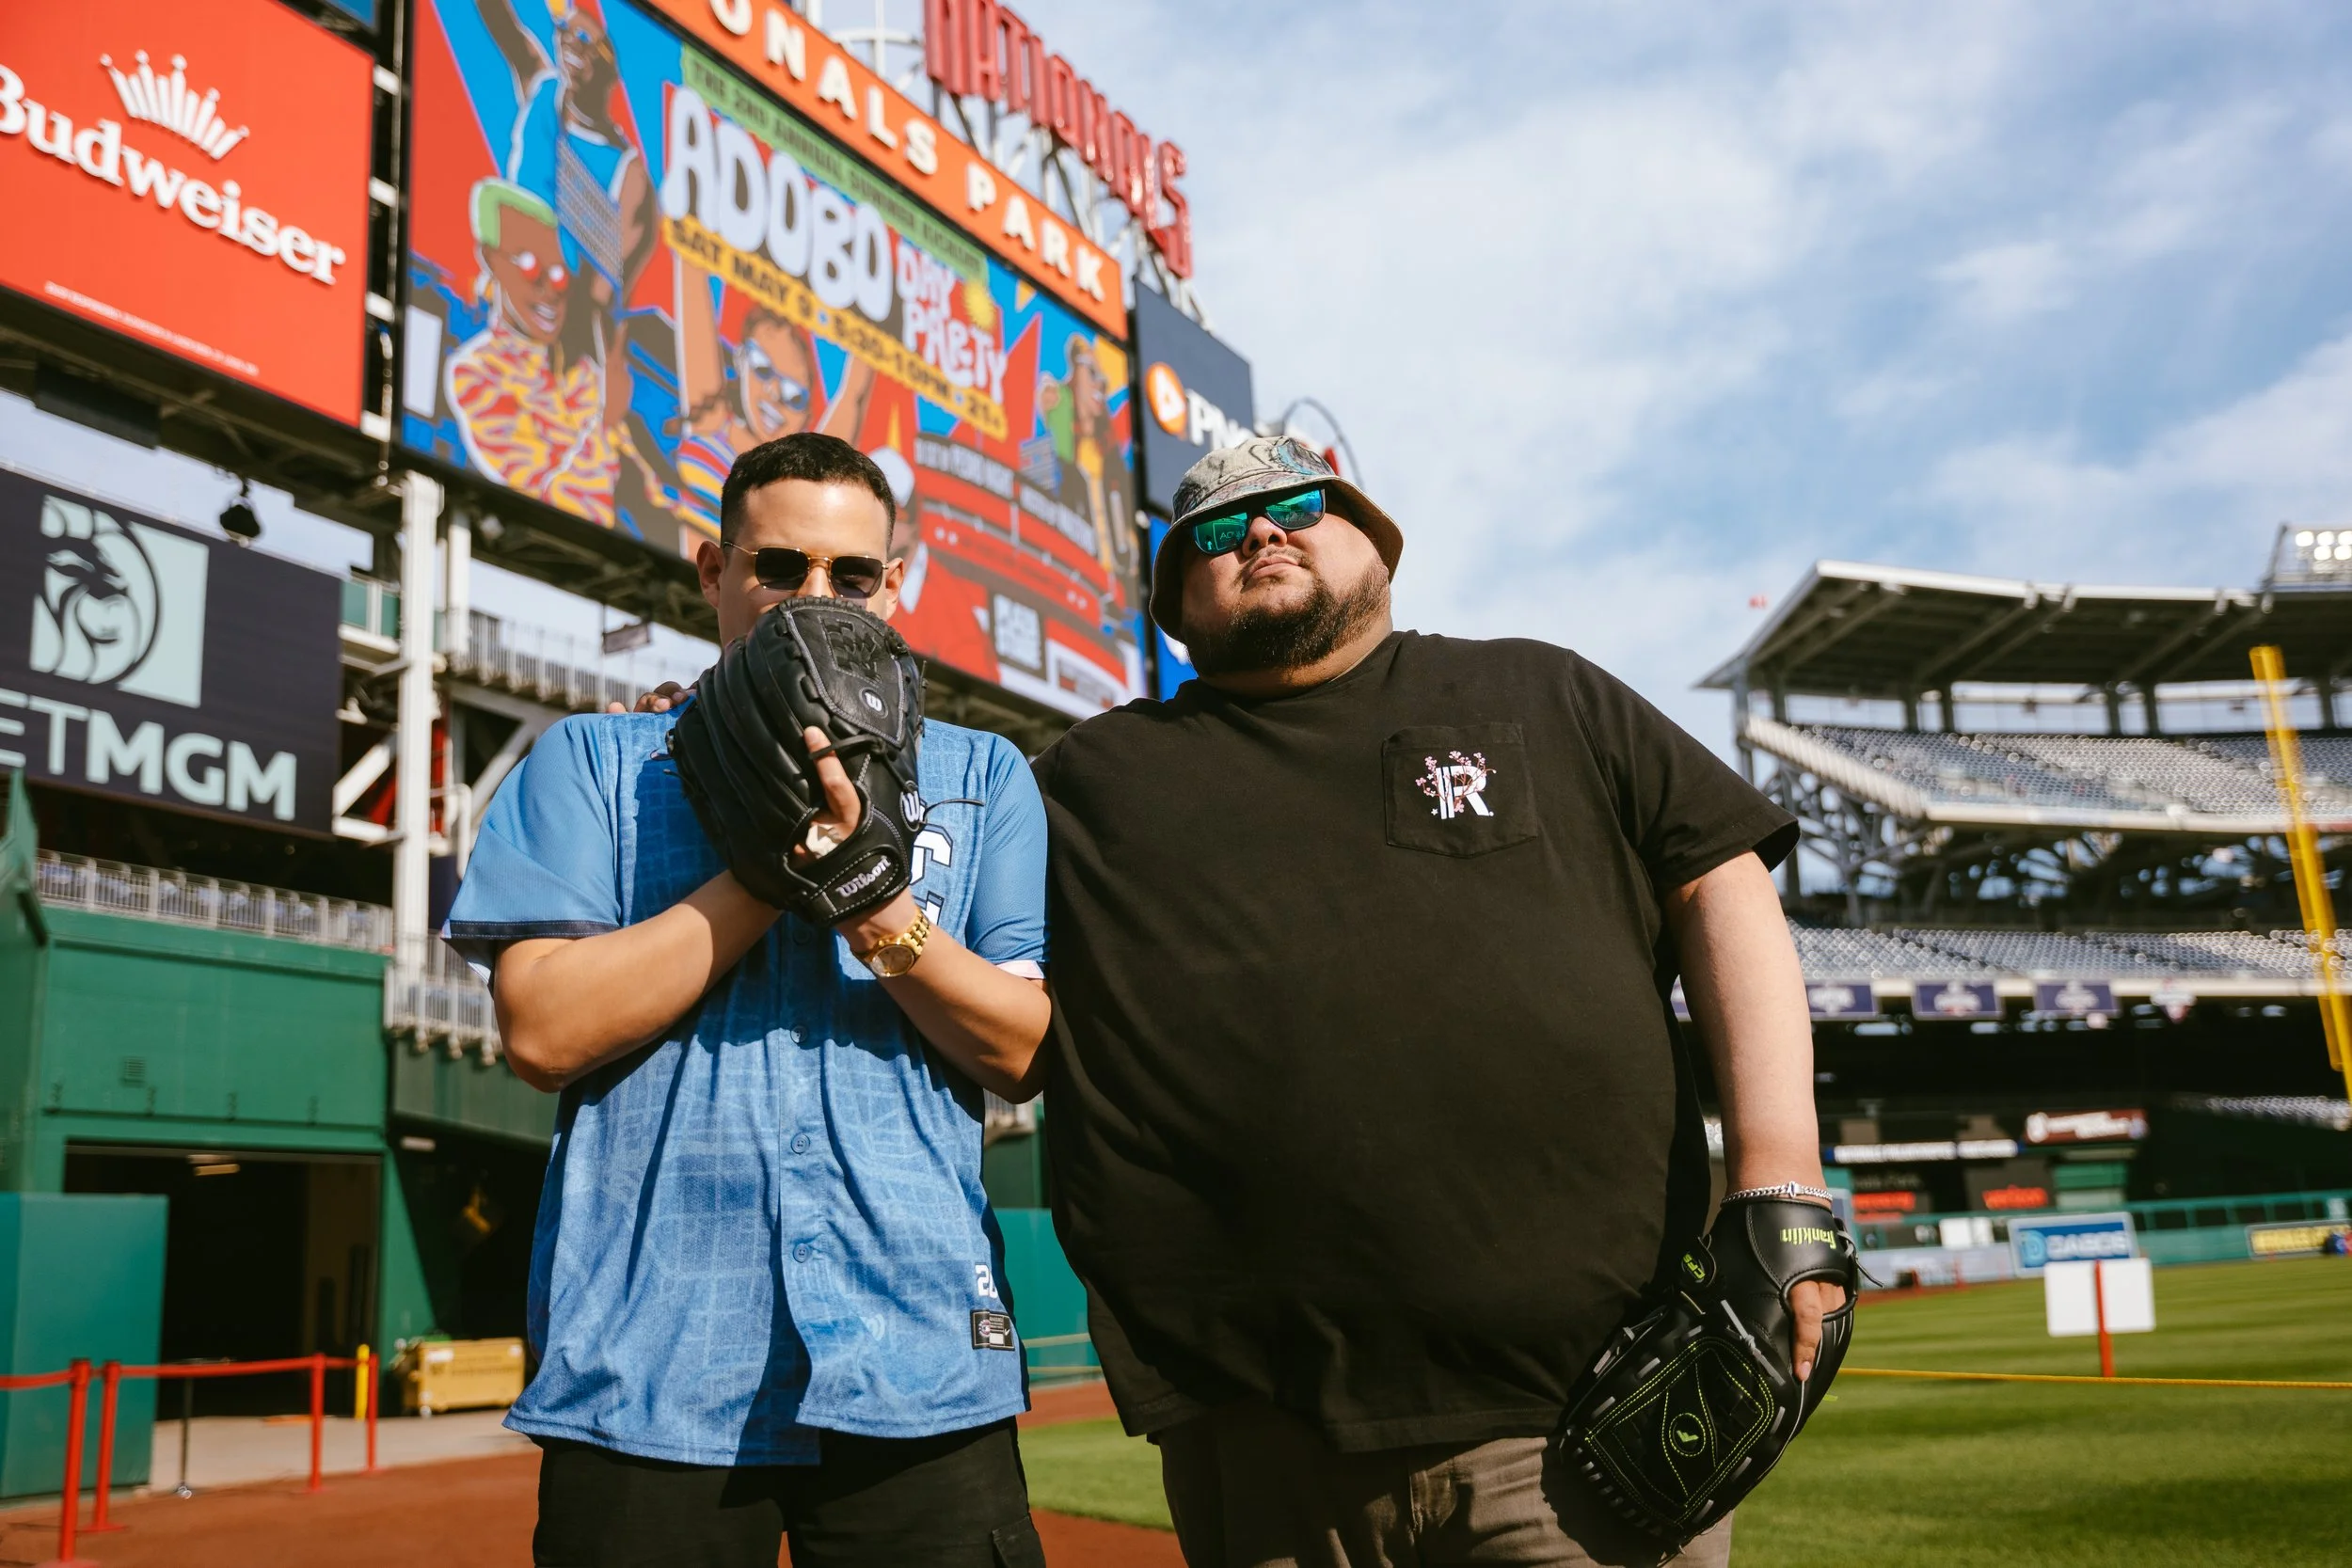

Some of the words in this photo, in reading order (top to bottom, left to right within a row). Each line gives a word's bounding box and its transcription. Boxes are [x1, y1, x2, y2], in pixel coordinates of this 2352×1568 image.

[662, 87, 892, 321] ADOBO
[966, 162, 1105, 302] PARK
[673, 219, 721, 264] SAT
[734, 254, 788, 305] MAY
[896, 239, 955, 319] DAY
[903, 299, 1008, 404] PARTY
[1187, 388, 1255, 450] PN
[835, 855, 891, 898] Wilson
[1781, 1227, 1836, 1249] franklin
